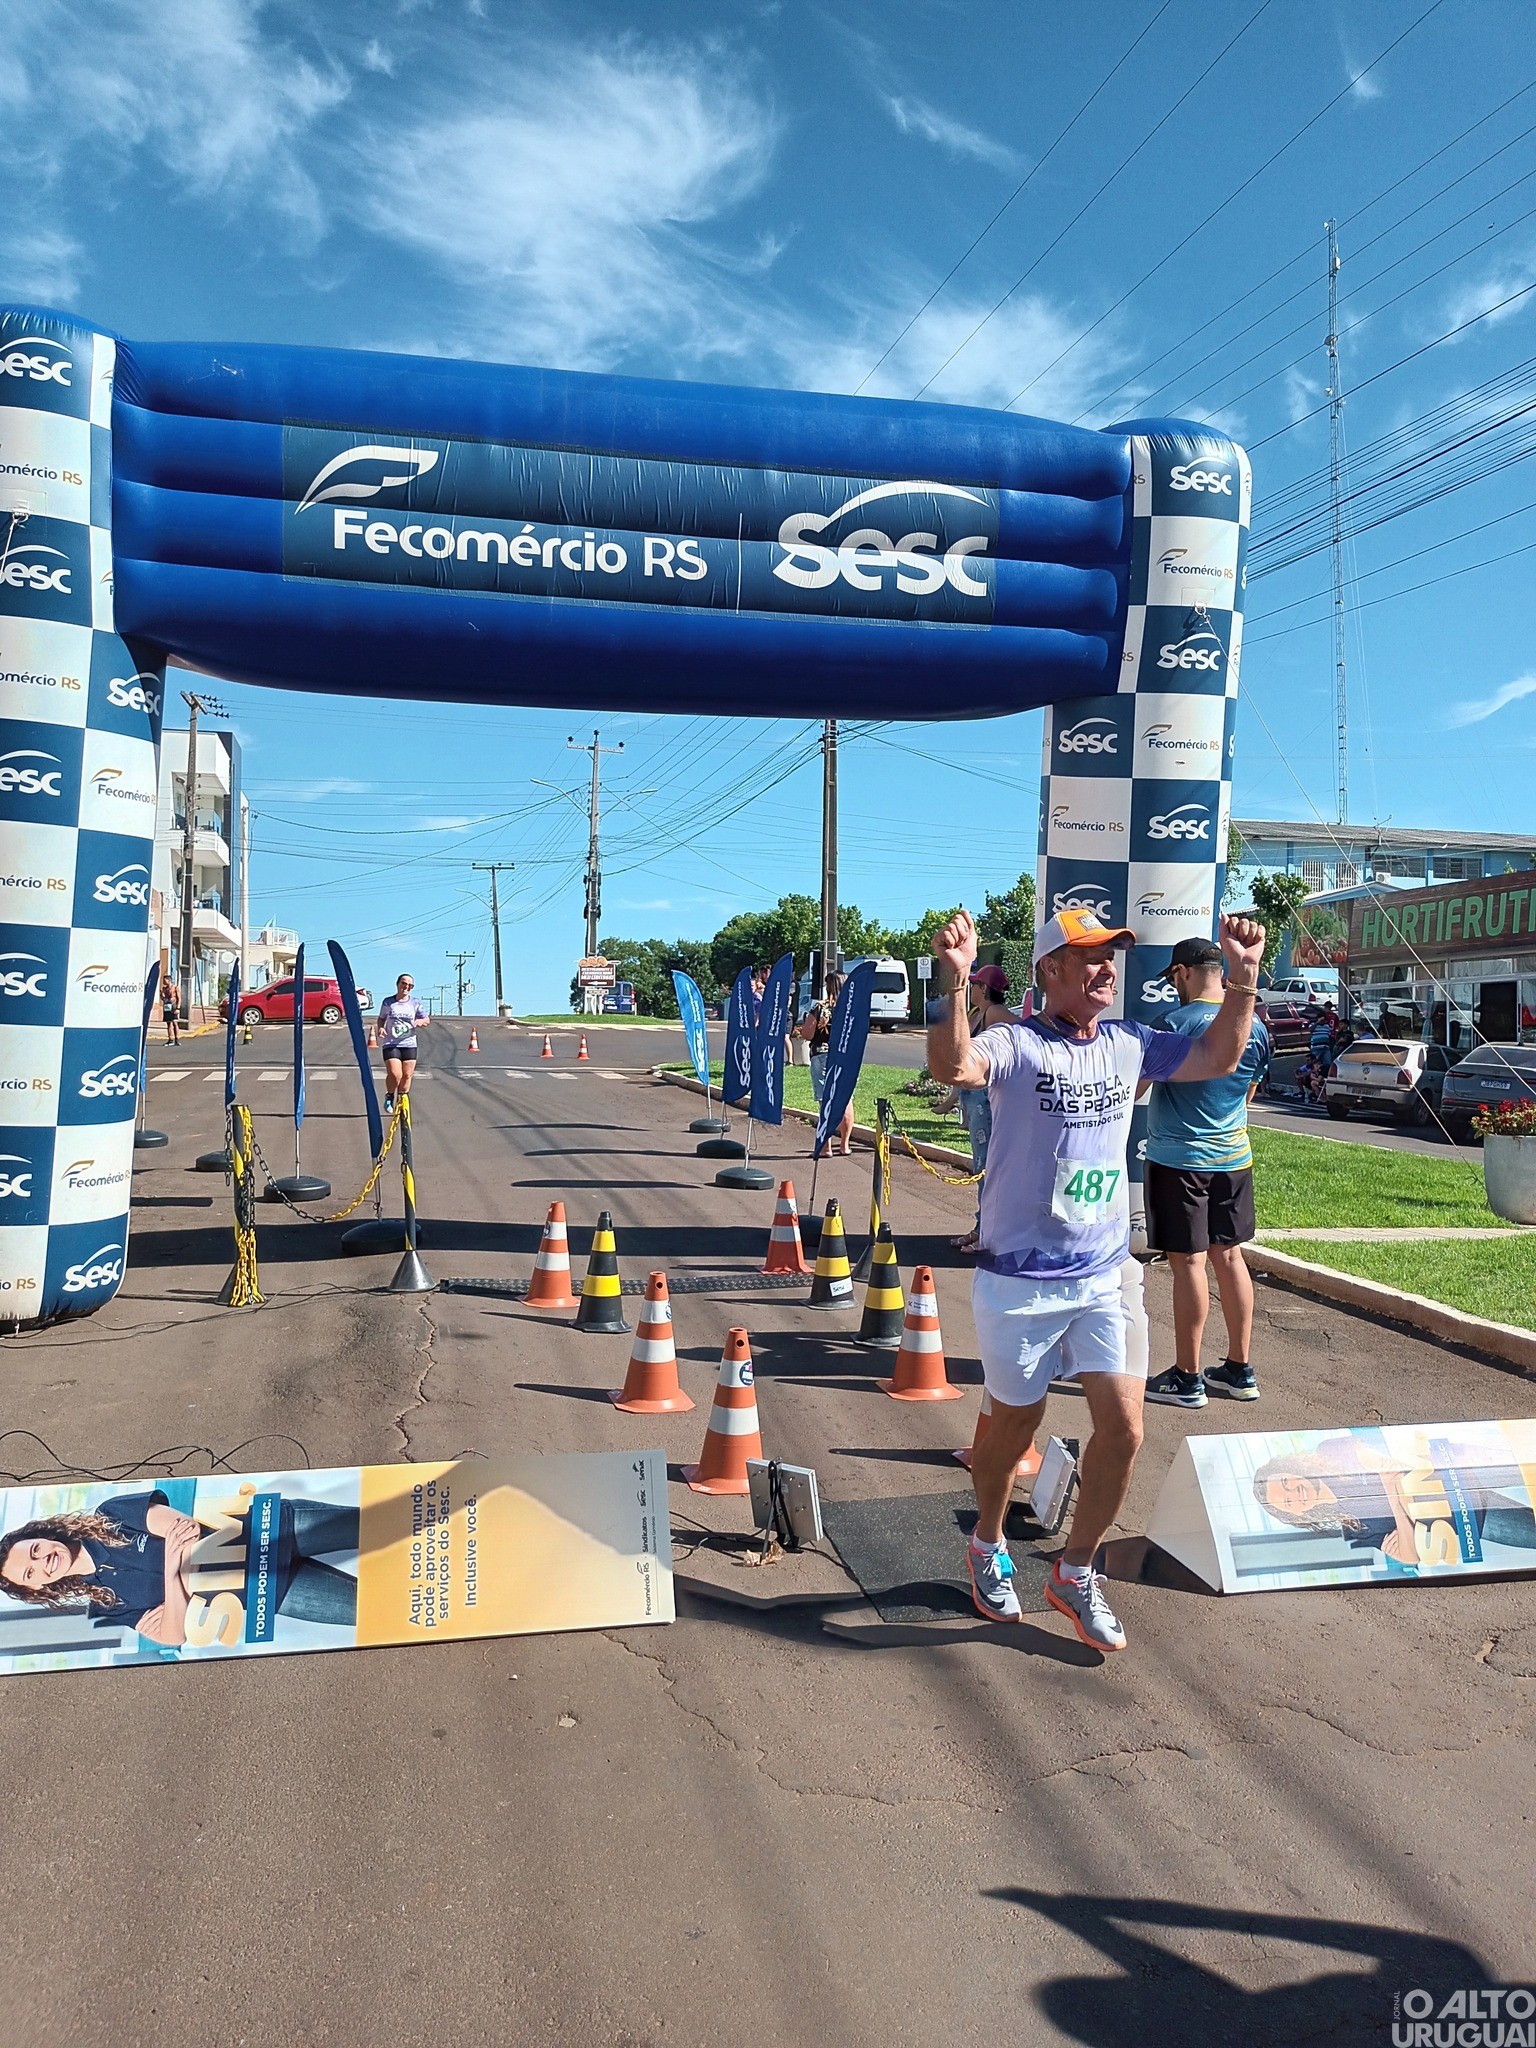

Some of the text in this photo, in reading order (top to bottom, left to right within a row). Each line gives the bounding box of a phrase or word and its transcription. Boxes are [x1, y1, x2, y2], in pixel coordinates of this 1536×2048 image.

[62, 471, 83, 486] RS
[1169, 465, 1232, 496] Sesc
[333, 509, 708, 581] Fecomércio RS
[772, 512, 989, 597] Sesc
[0, 561, 72, 595] esc
[1163, 562, 1222, 577] Fecomércio
[1223, 569, 1234, 580] RS
[1156, 644, 1221, 671] Sesc
[61, 677, 82, 691] RS
[106, 677, 161, 717] Sesc
[1058, 729, 1118, 754] Sesc
[1148, 737, 1208, 751] Fecomércio
[1209, 740, 1220, 751] RS
[0, 766, 62, 797] esc
[98, 783, 151, 804] Fecomércio
[1053, 817, 1106, 833] Fecomércio
[1108, 821, 1125, 833] RS
[1146, 815, 1210, 841] Sesc
[46, 878, 67, 892] RS
[93, 874, 149, 906] Sesc
[1141, 904, 1211, 917] Fecomércio RS
[83, 981, 138, 994] Fecomércio
[1141, 980, 1179, 1003] Se
[740, 1035, 751, 1088] Sesc
[32, 1078, 53, 1091] RS
[78, 1069, 136, 1098] Sesc
[1060, 1074, 1123, 1098] RÚSTCA
[1040, 1098, 1080, 1114] DAS
[68, 1172, 124, 1189] Fecomércio
[1064, 1169, 1121, 1203] 487
[16, 1278, 37, 1291] RS
[62, 1258, 122, 1293] Sesc
[1159, 1384, 1179, 1393] FILA
[1449, 1469, 1460, 1487] SER
[1454, 1488, 1471, 1523] PODEM
[641, 1516, 649, 1552] Sindicatos
[1461, 1523, 1476, 1559] TODOS
[408, 1484, 423, 1625] Aqui, todo mundo
[423, 1480, 437, 1627] pode aproveitar os
[437, 1486, 451, 1619] serviços do Sesc.
[464, 1494, 477, 1606] Inclusive você.
[255, 1498, 272, 1638] TODOS PODEM SER SESC.
[643, 1574, 652, 1616] Fecomércio
